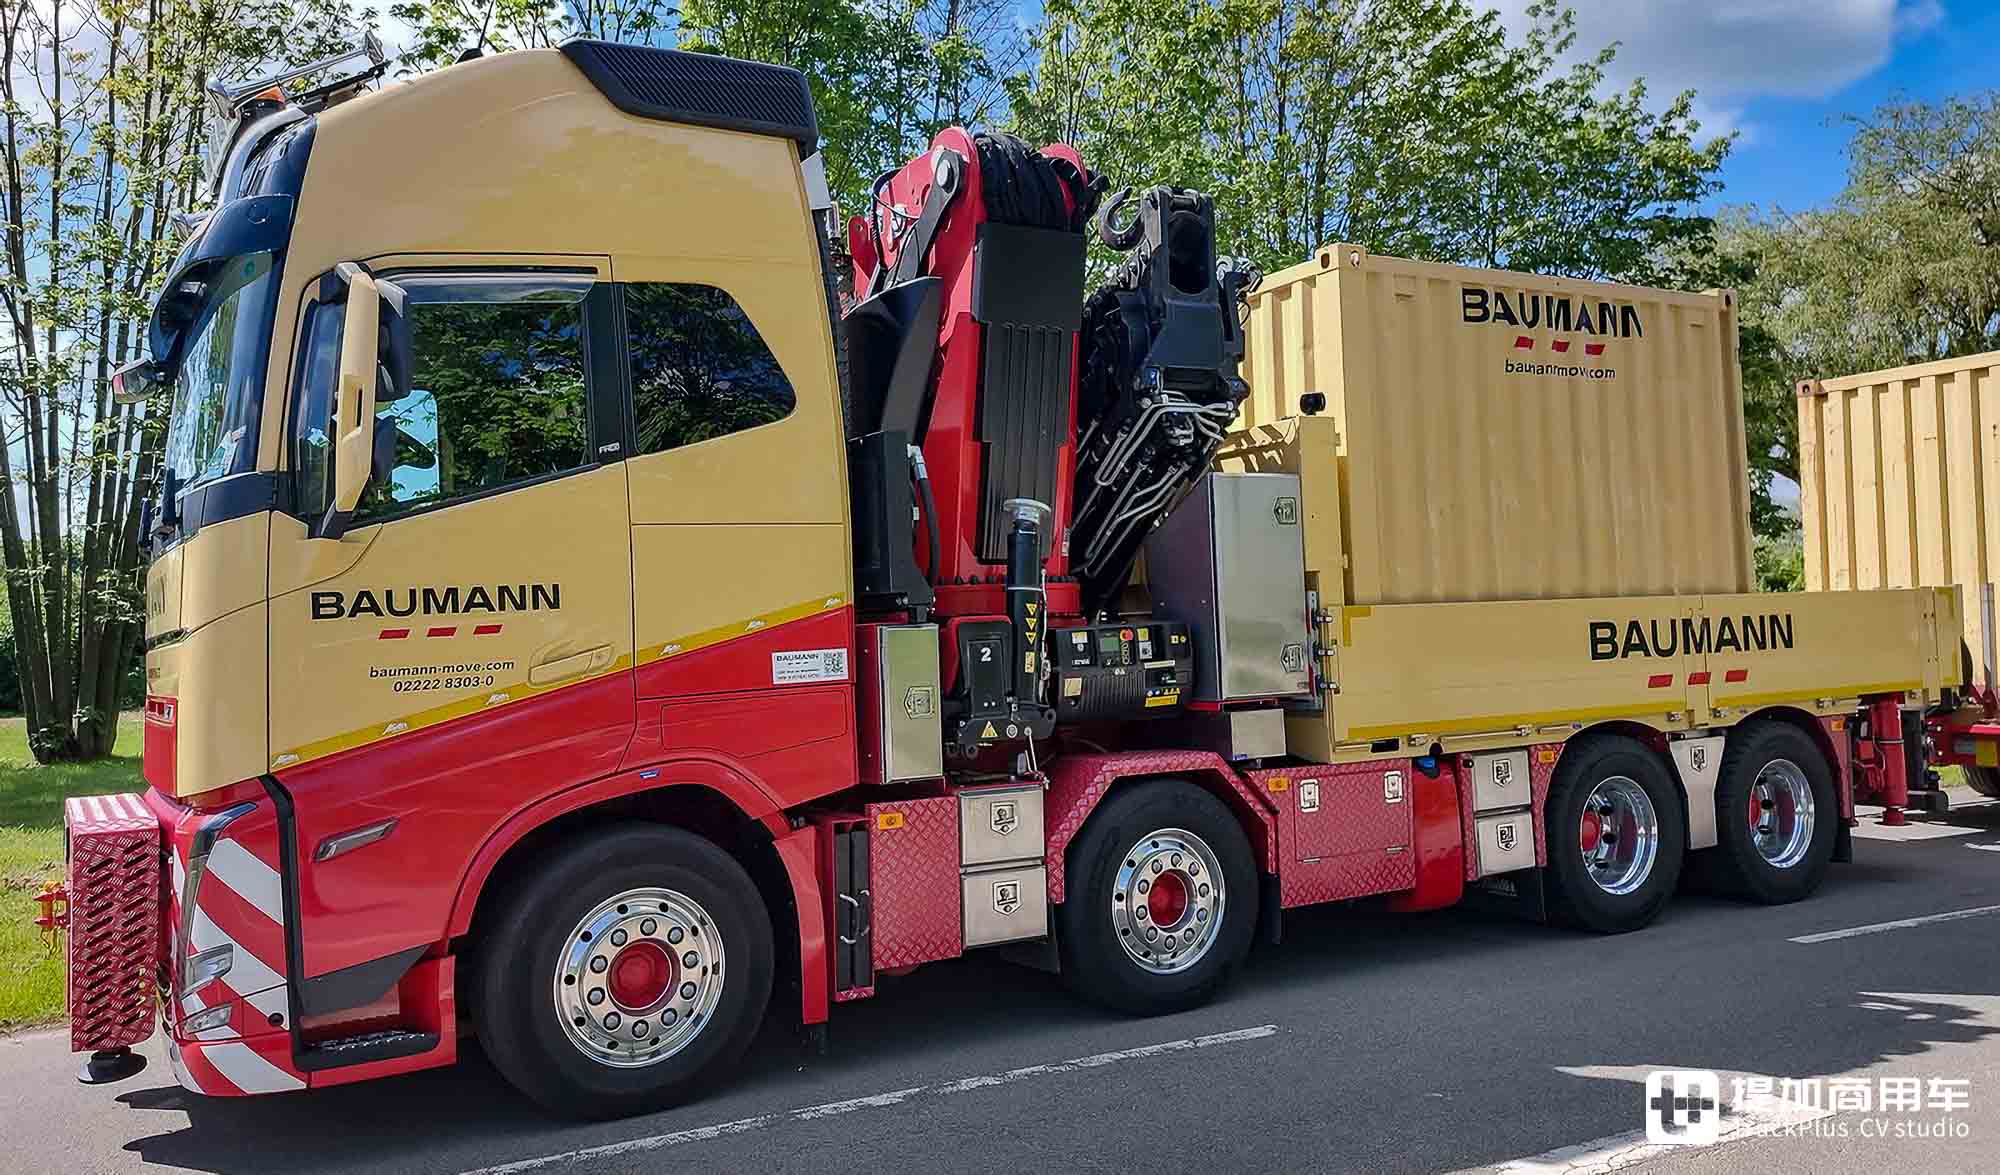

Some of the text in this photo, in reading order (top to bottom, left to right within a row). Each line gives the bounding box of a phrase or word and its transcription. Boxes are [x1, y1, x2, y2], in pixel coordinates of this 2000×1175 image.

[1461, 287, 1643, 338] BAUMANN
[311, 583, 561, 620] BAUMANN
[1589, 613, 1794, 661] BAUMANN
[369, 659, 515, 678] baumann-move.com
[980, 647, 992, 662] 2
[393, 675, 494, 693] 02222 8303-0
